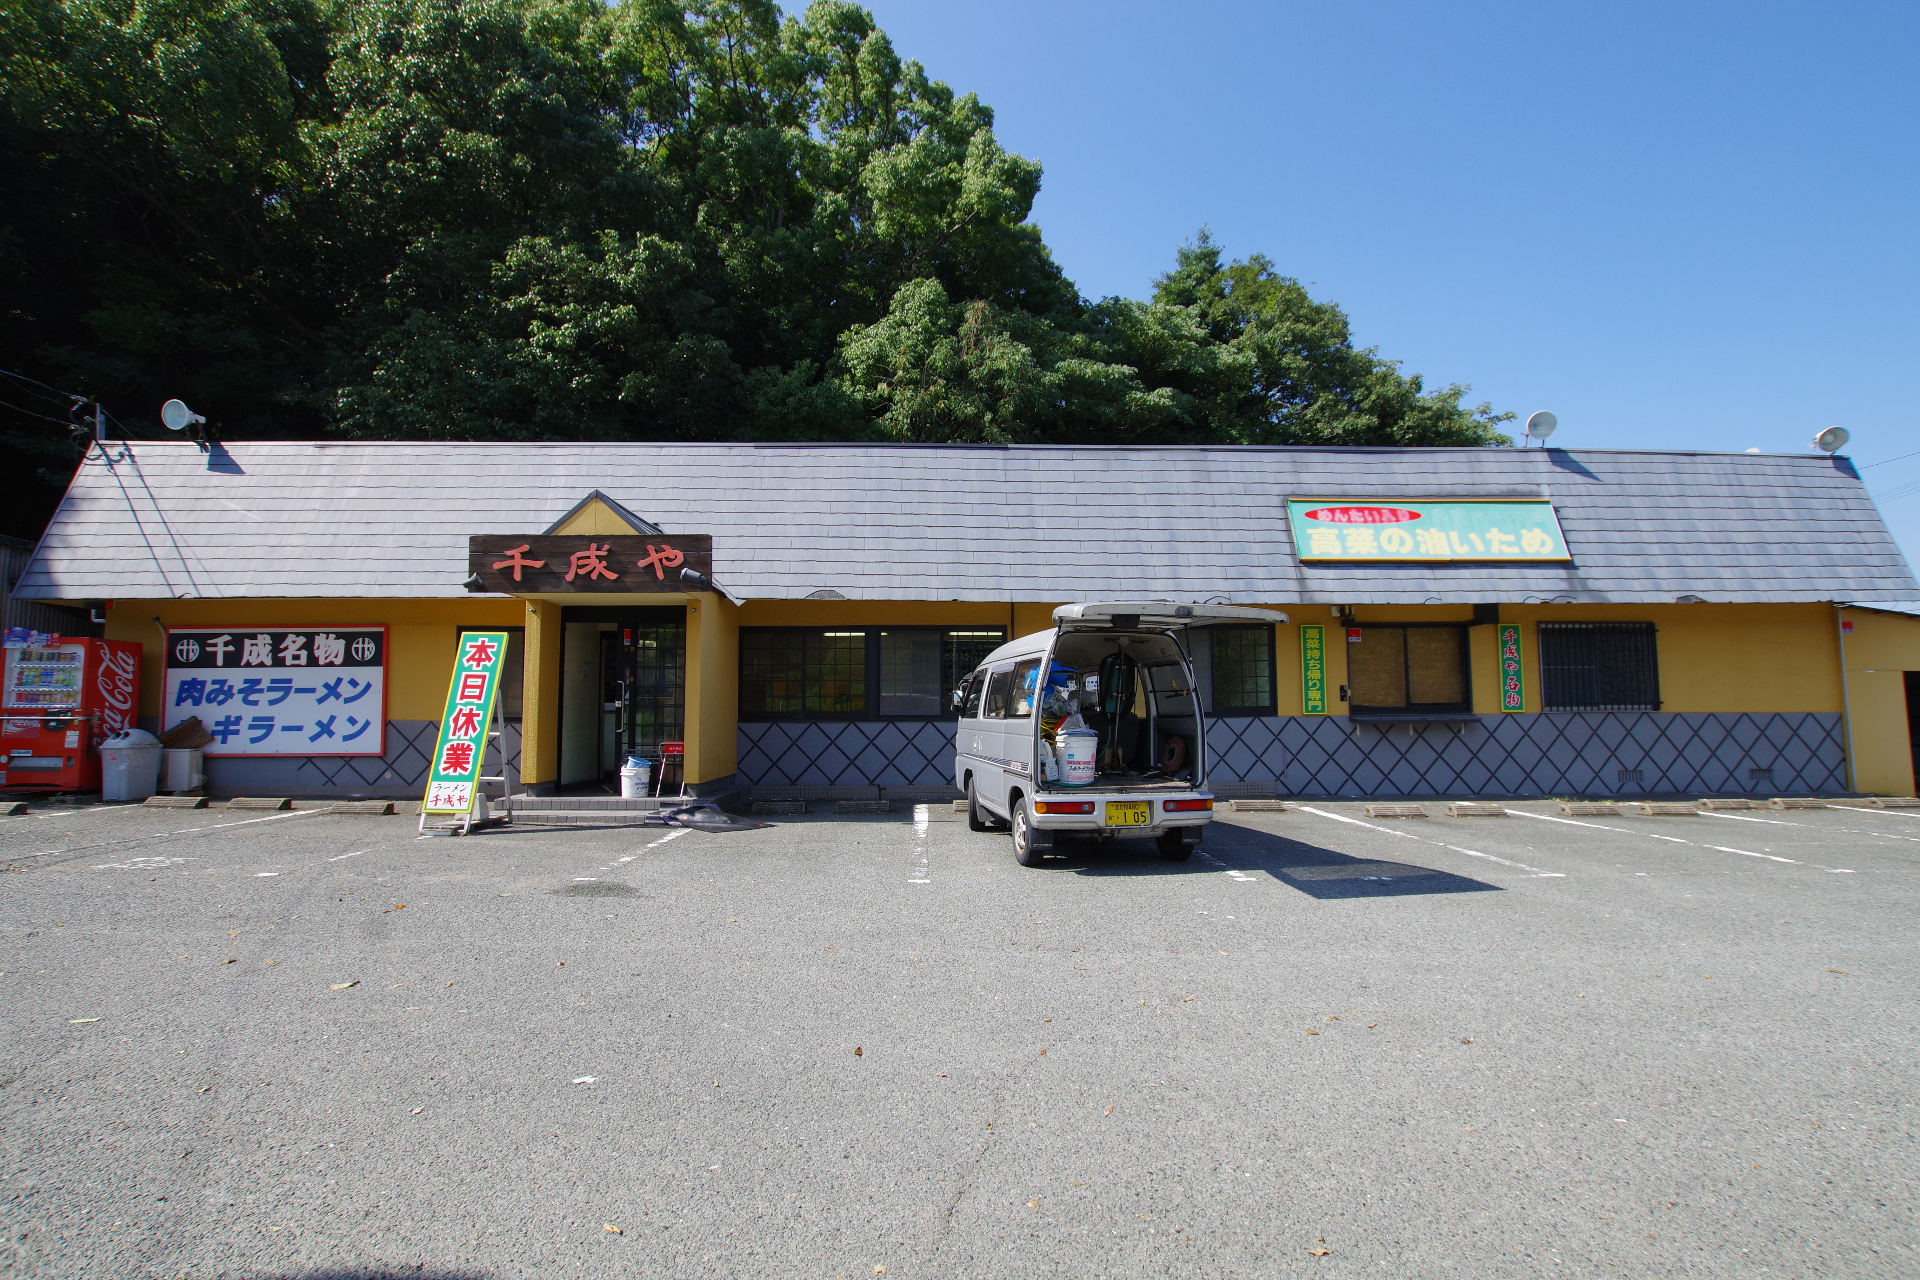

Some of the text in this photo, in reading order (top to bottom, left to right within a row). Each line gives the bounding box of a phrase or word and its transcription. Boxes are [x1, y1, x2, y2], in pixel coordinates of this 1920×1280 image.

[1307, 527, 1554, 555] 高菜の油いため
[492, 542, 685, 582] 千成や
[205, 633, 347, 667] 千成名物
[1306, 628, 1322, 711] 高菜持ち帰り専門
[1503, 628, 1521, 707] 千成や名物
[175, 676, 373, 707] 肉みそラーメン
[440, 638, 497, 775] 本日休業
[180, 714, 372, 745] ギラーメン
[430, 794, 469, 808] 千成や
[434, 784, 468, 793] ラーメン
